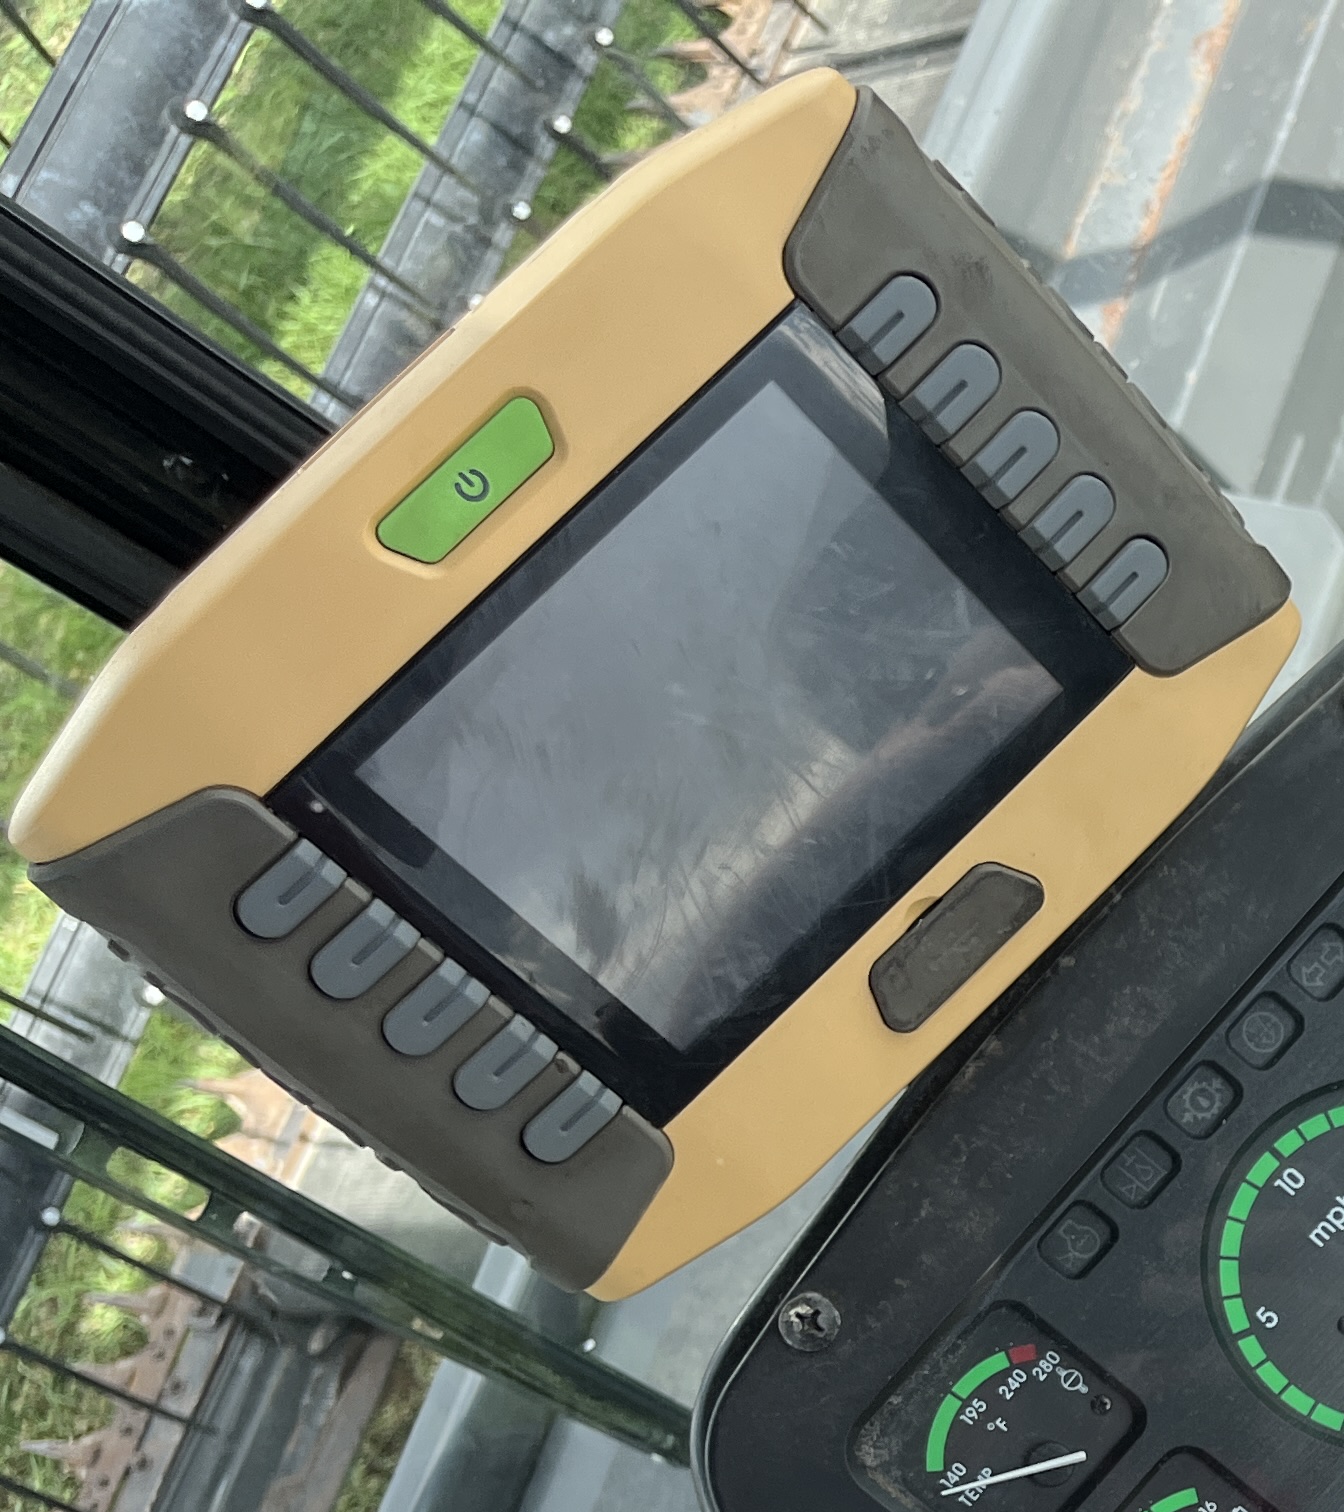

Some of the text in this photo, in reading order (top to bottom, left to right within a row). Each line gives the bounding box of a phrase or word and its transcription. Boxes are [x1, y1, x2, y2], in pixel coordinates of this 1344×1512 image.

[1274, 1167, 1306, 1196] 10
[1256, 1306, 1279, 1329] 5
[1032, 1351, 1060, 1382] 280
[998, 1368, 1028, 1400] 240
[959, 1398, 987, 1425] 195
[939, 1462, 967, 1489] 140
